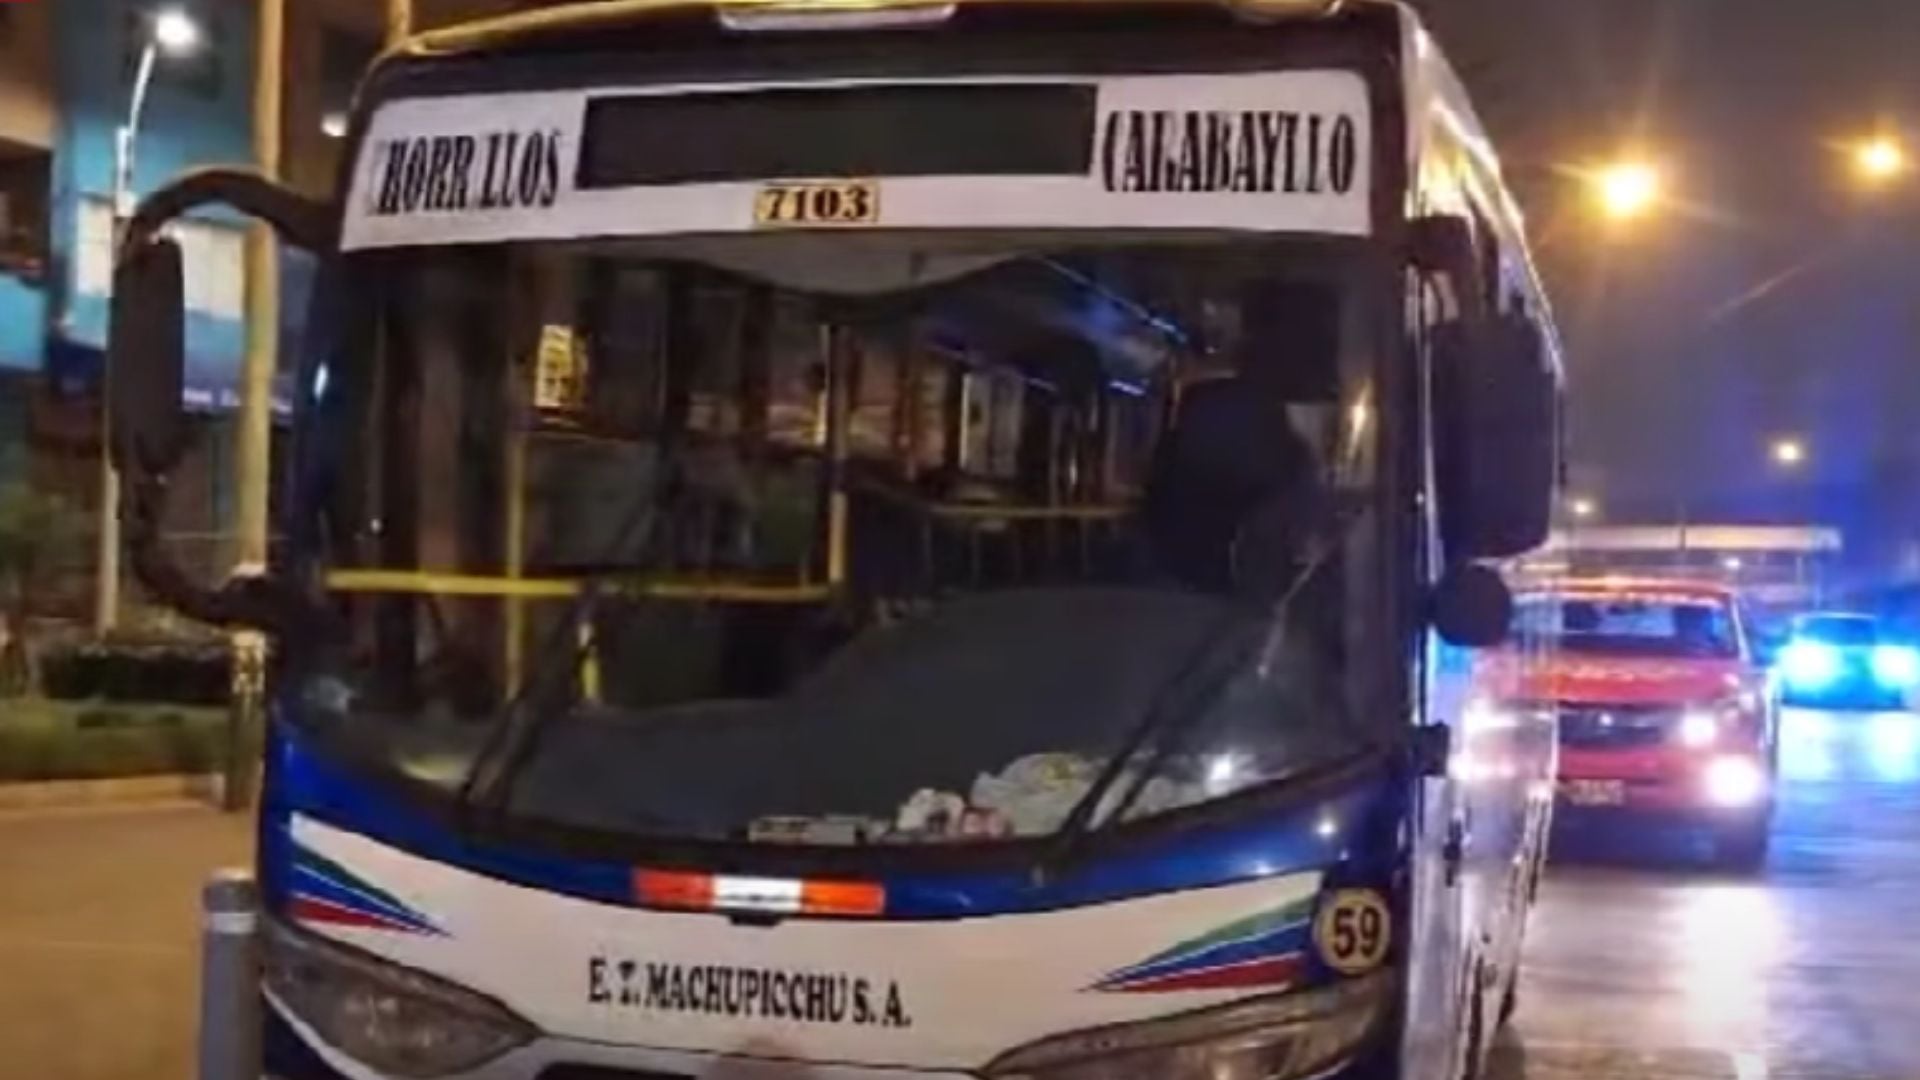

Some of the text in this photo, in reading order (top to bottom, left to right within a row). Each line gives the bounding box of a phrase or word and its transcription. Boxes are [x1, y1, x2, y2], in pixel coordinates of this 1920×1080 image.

[368, 129, 560, 215] HORRLLOS
[763, 186, 869, 220] 7103
[1334, 907, 1380, 959] 59
[645, 961, 847, 1023] MACHUPICCHU
